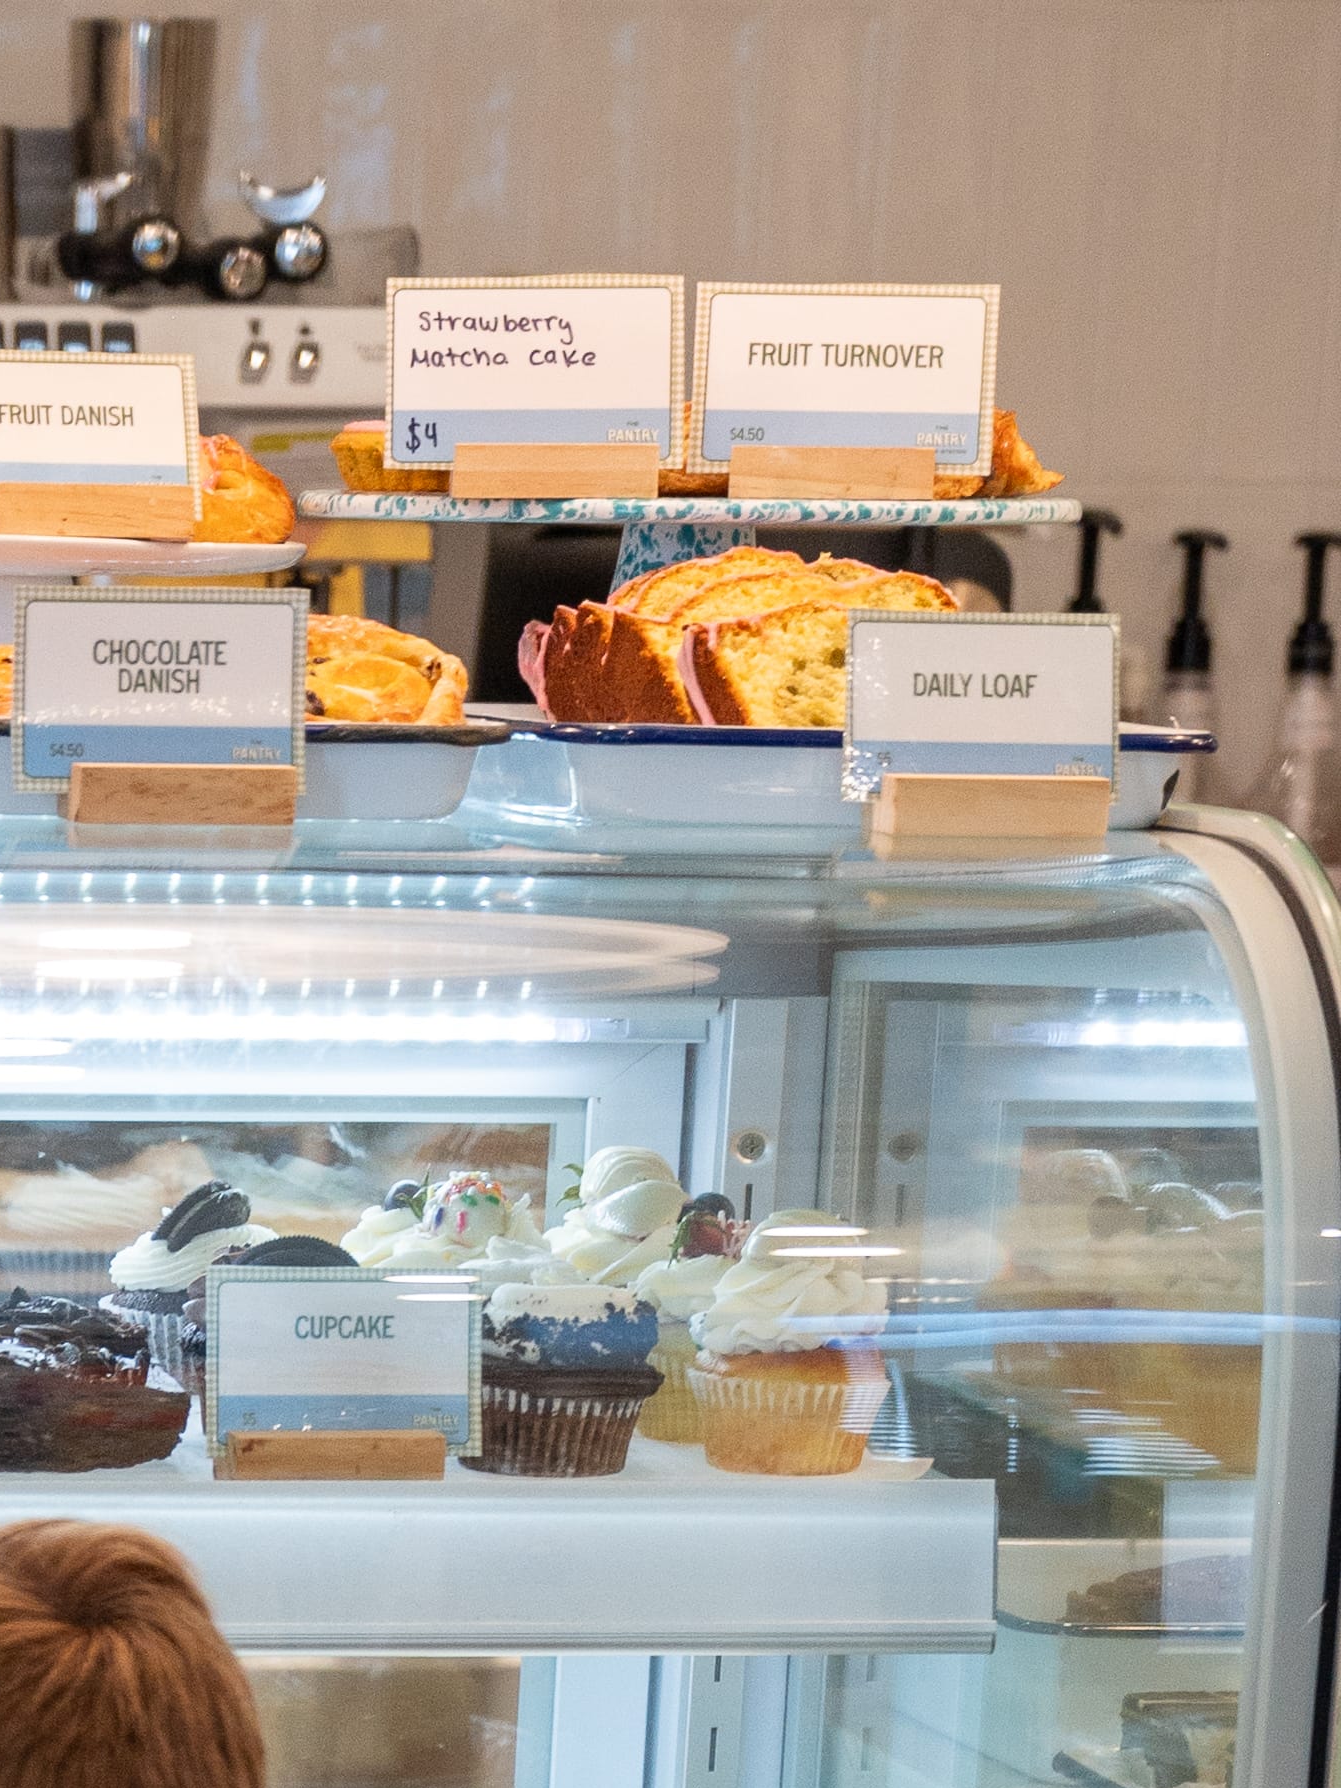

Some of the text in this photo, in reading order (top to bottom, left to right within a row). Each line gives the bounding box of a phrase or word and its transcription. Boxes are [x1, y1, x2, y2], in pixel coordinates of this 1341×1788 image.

[418, 311, 573, 345] Strawberry
[410, 348, 510, 368] Matcha
[748, 342, 945, 369] FRUIT TURNOVER
[61, 405, 135, 427] DANISH
[406, 417, 439, 453] $4
[607, 429, 660, 442] PANTRY
[730, 427, 765, 441] $4.50
[916, 432, 967, 447] PANTRY
[93, 639, 228, 666] CHOCOLATE
[118, 668, 200, 694] DANISH
[913, 673, 1038, 699] DAILY LOAF
[294, 1315, 395, 1339] CUPCAKE
